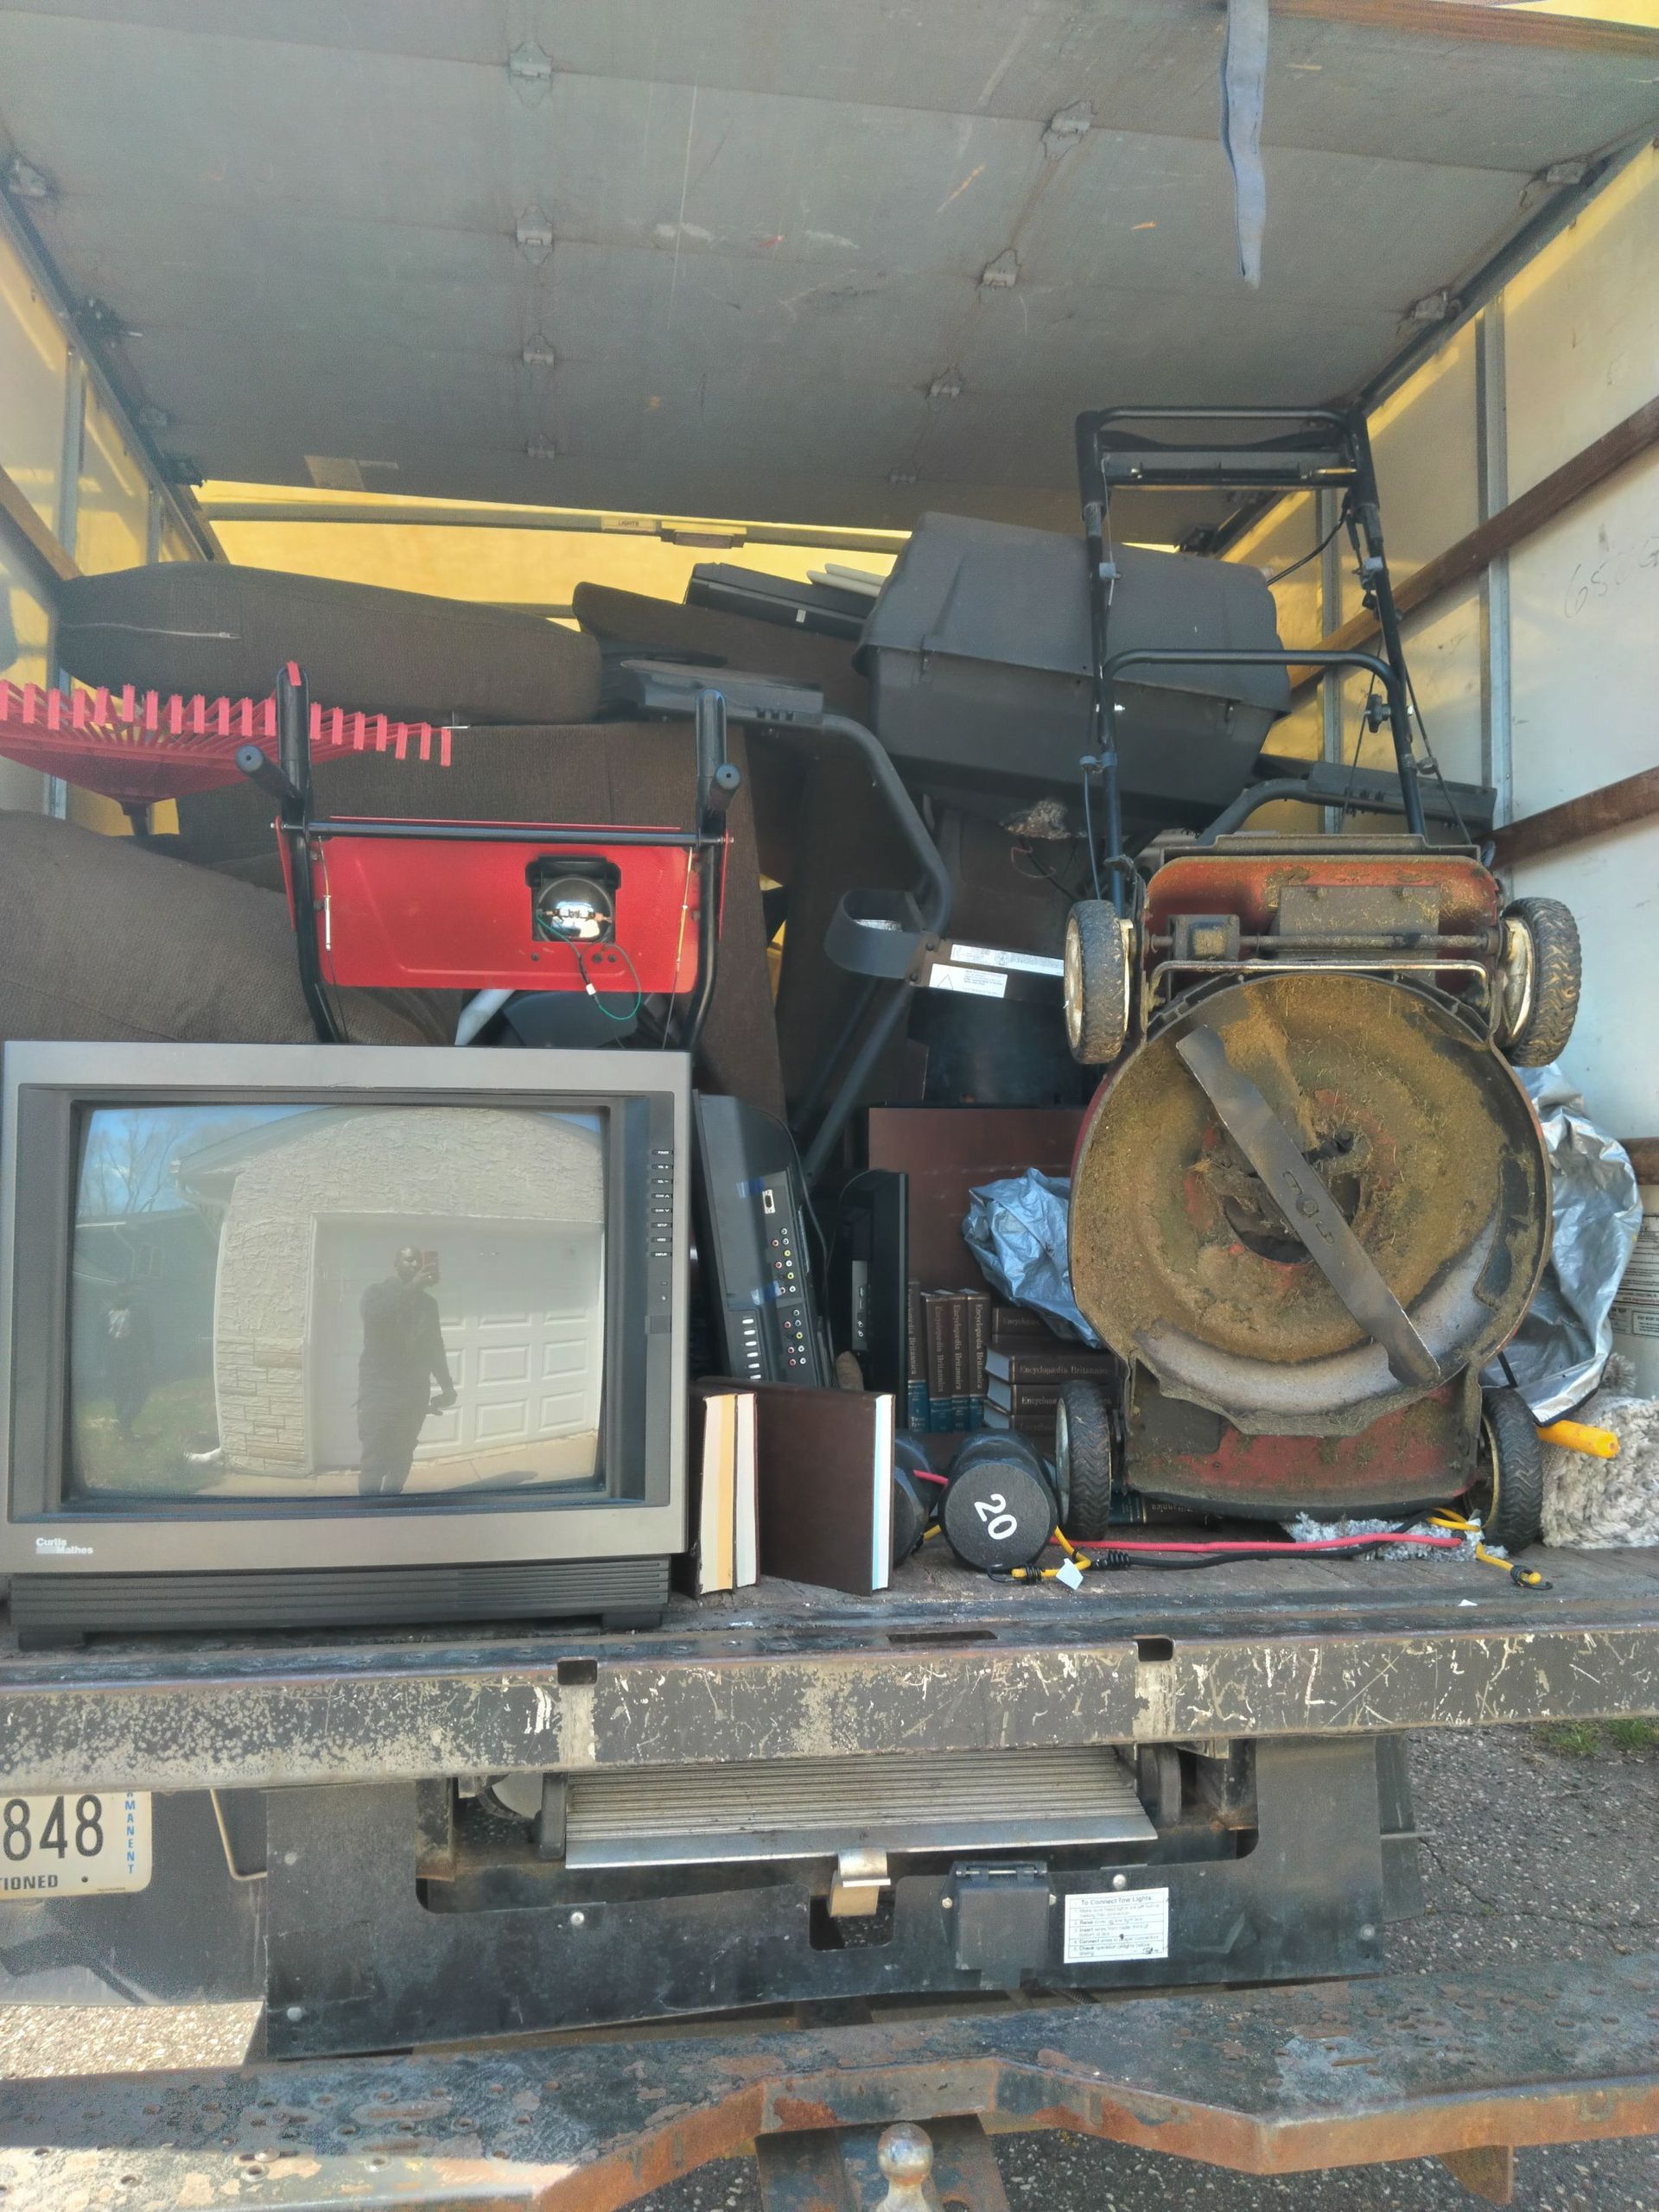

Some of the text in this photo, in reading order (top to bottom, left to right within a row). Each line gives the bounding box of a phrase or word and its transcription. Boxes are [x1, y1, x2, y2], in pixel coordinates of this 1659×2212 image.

[974, 1493, 1018, 1540] 20
[35, 1538, 67, 1547] Curtis
[56, 1546, 94, 1555] Mathes
[3, 1793, 104, 1861] 848
